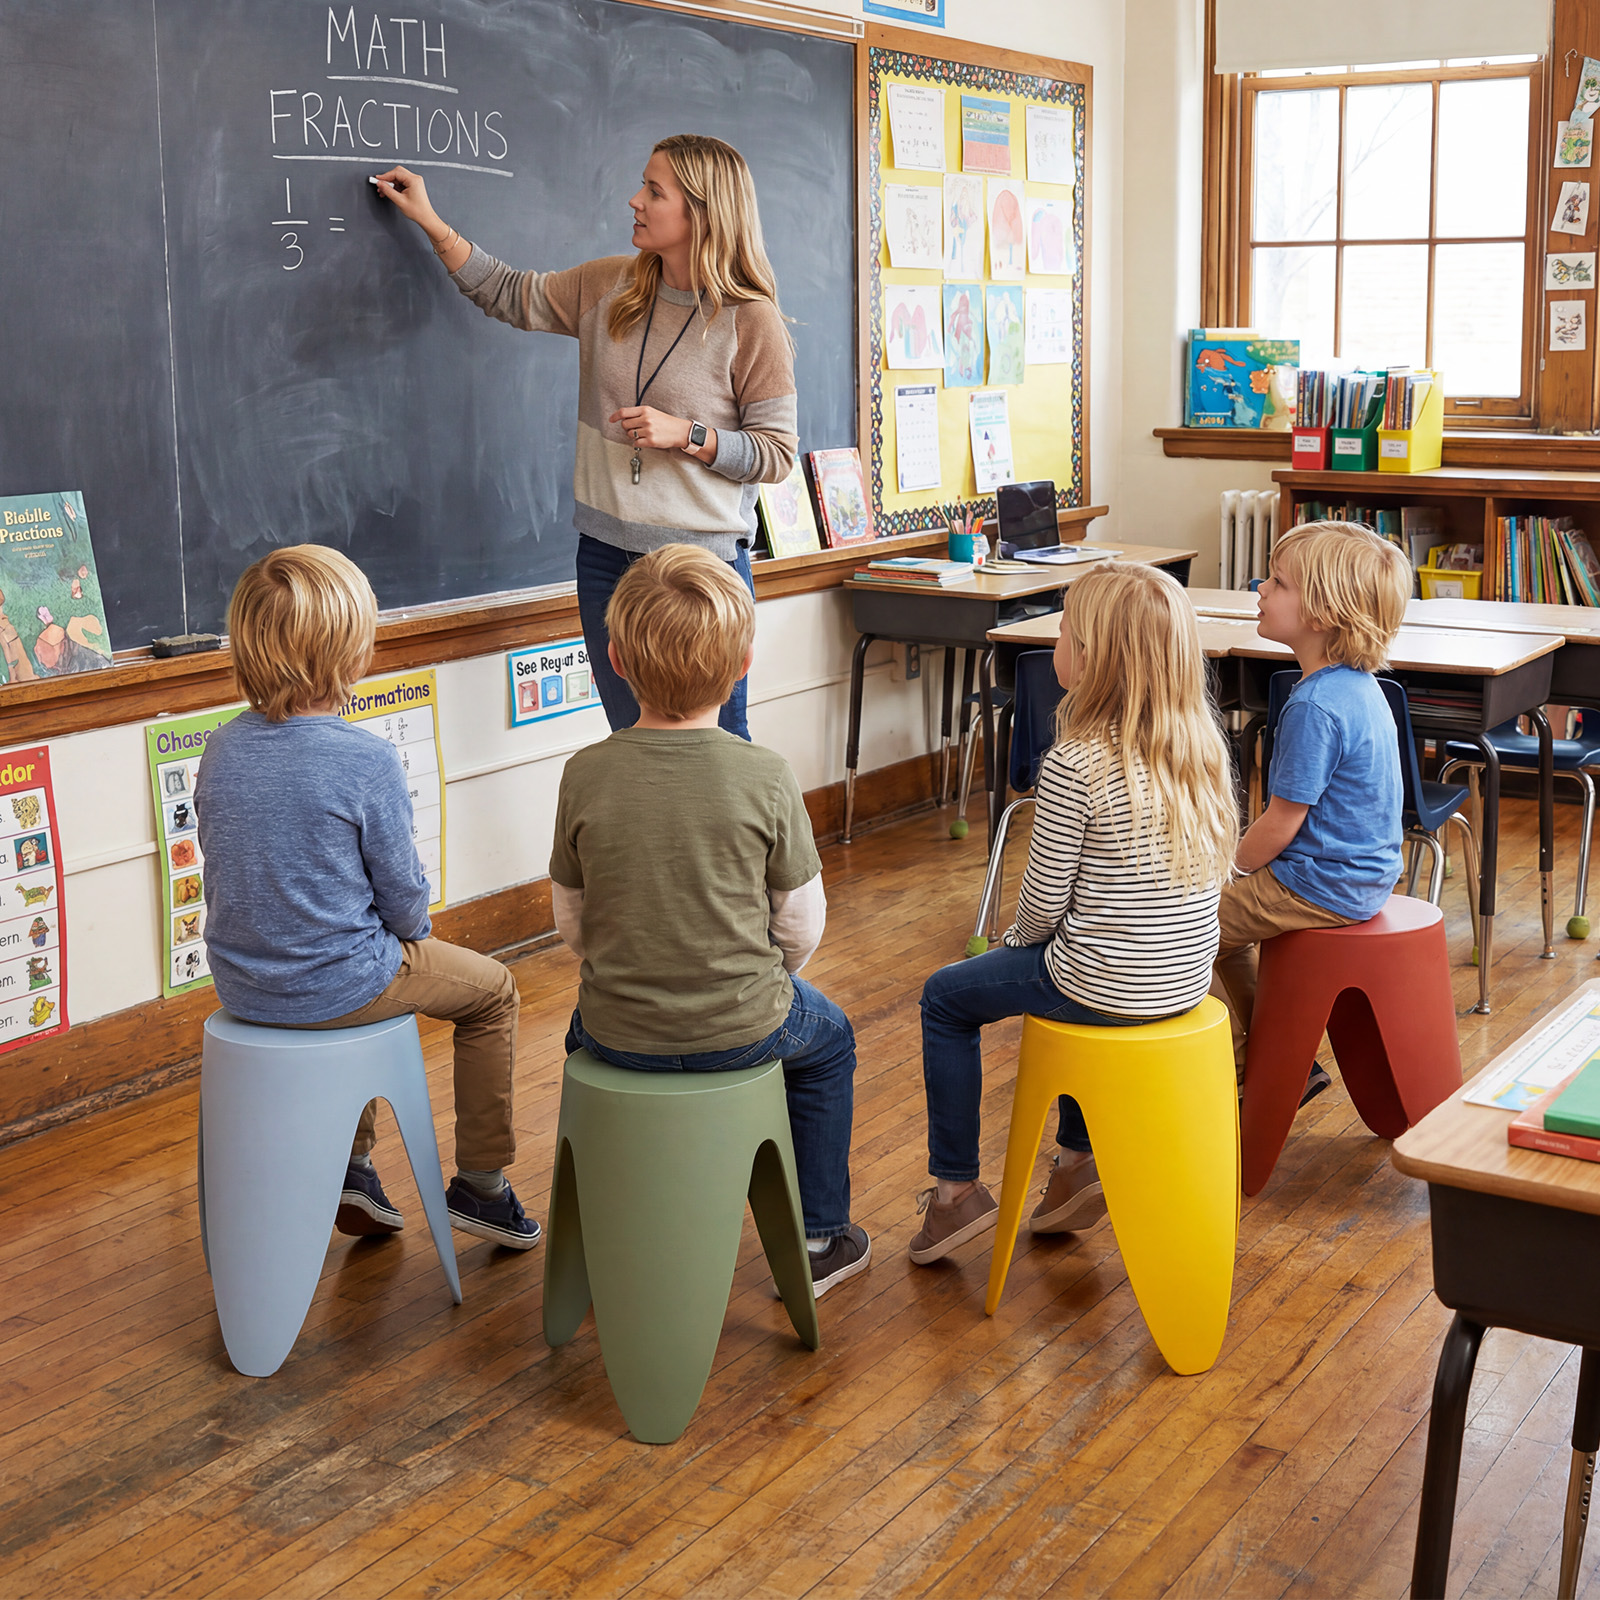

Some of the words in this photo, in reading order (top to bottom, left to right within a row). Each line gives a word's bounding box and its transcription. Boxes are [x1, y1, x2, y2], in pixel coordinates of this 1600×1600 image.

[326, 5, 447, 78] MATH
[269, 89, 508, 160] FRACTIONS
[280, 231, 304, 271] 3
[516, 661, 537, 677] See
[156, 721, 222, 754] Chas
[0, 763, 35, 787] dor
